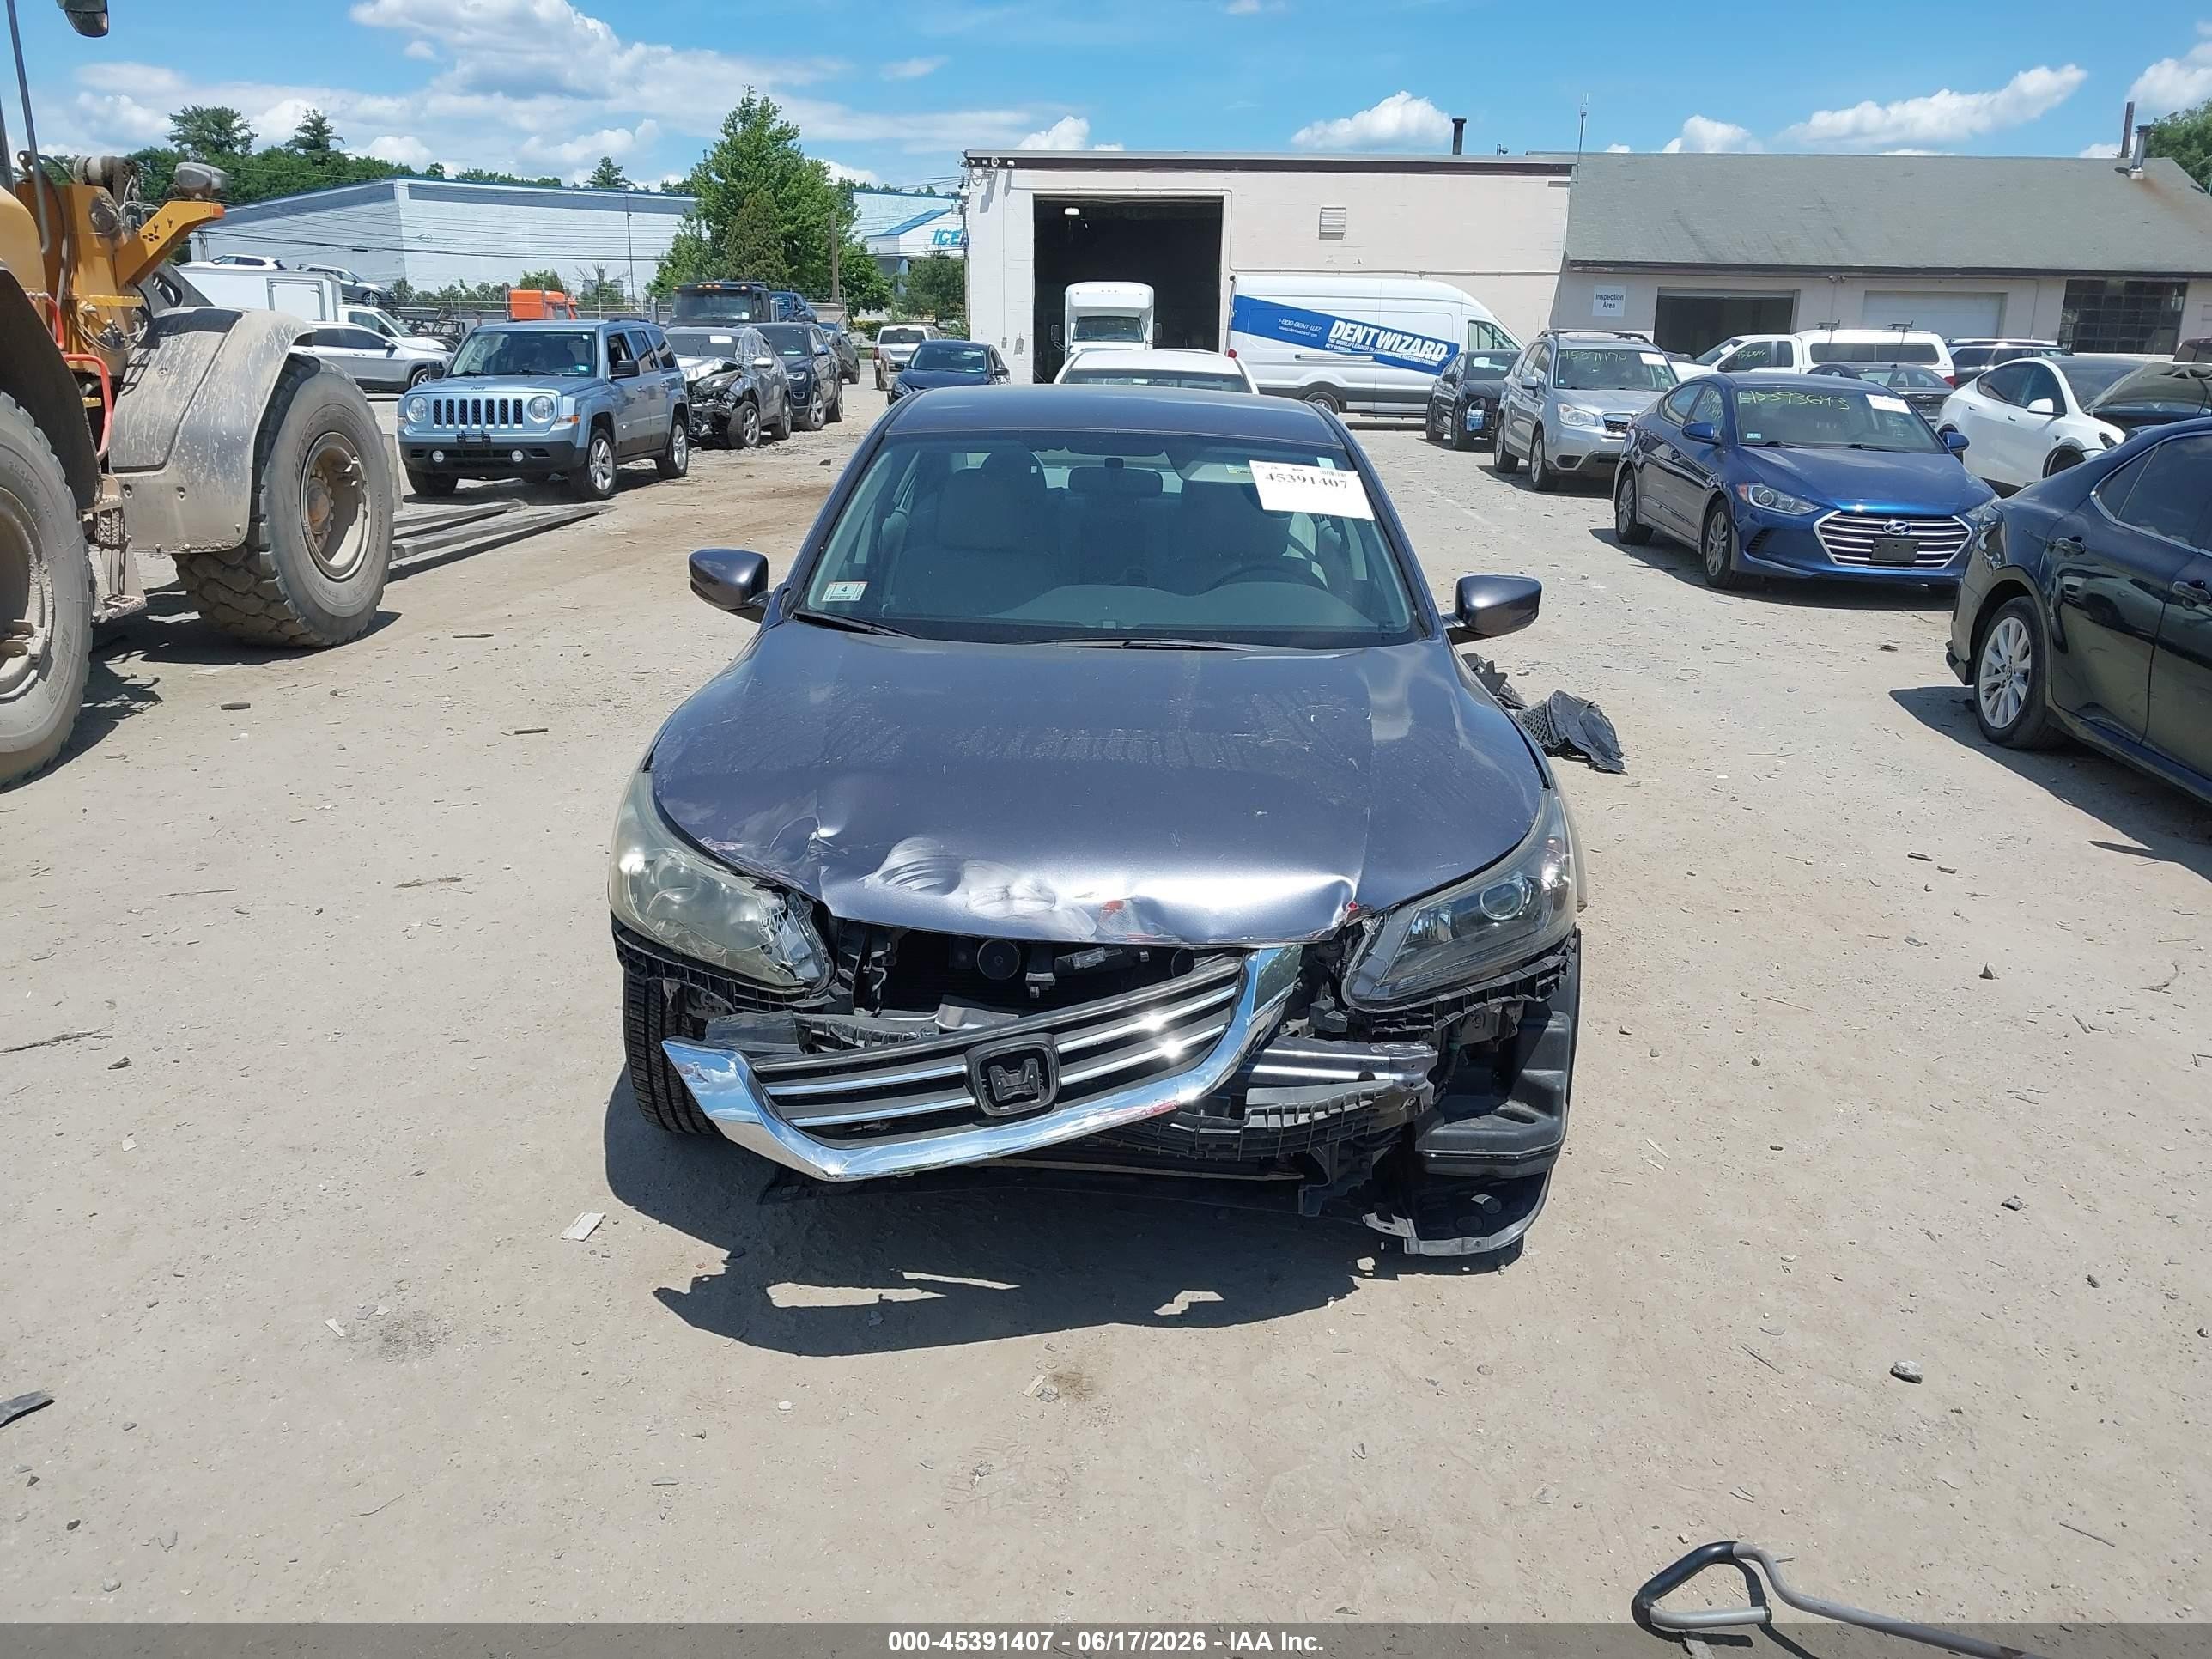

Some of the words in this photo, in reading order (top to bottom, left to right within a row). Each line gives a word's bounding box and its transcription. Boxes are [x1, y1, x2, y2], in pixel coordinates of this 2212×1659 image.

[1595, 293, 1624, 301] Inspection
[1602, 301, 1616, 309] Area
[1351, 343, 1370, 351] LEADER
[1376, 330, 1448, 362] WIZARD
[1265, 473, 1347, 489] 45391407
